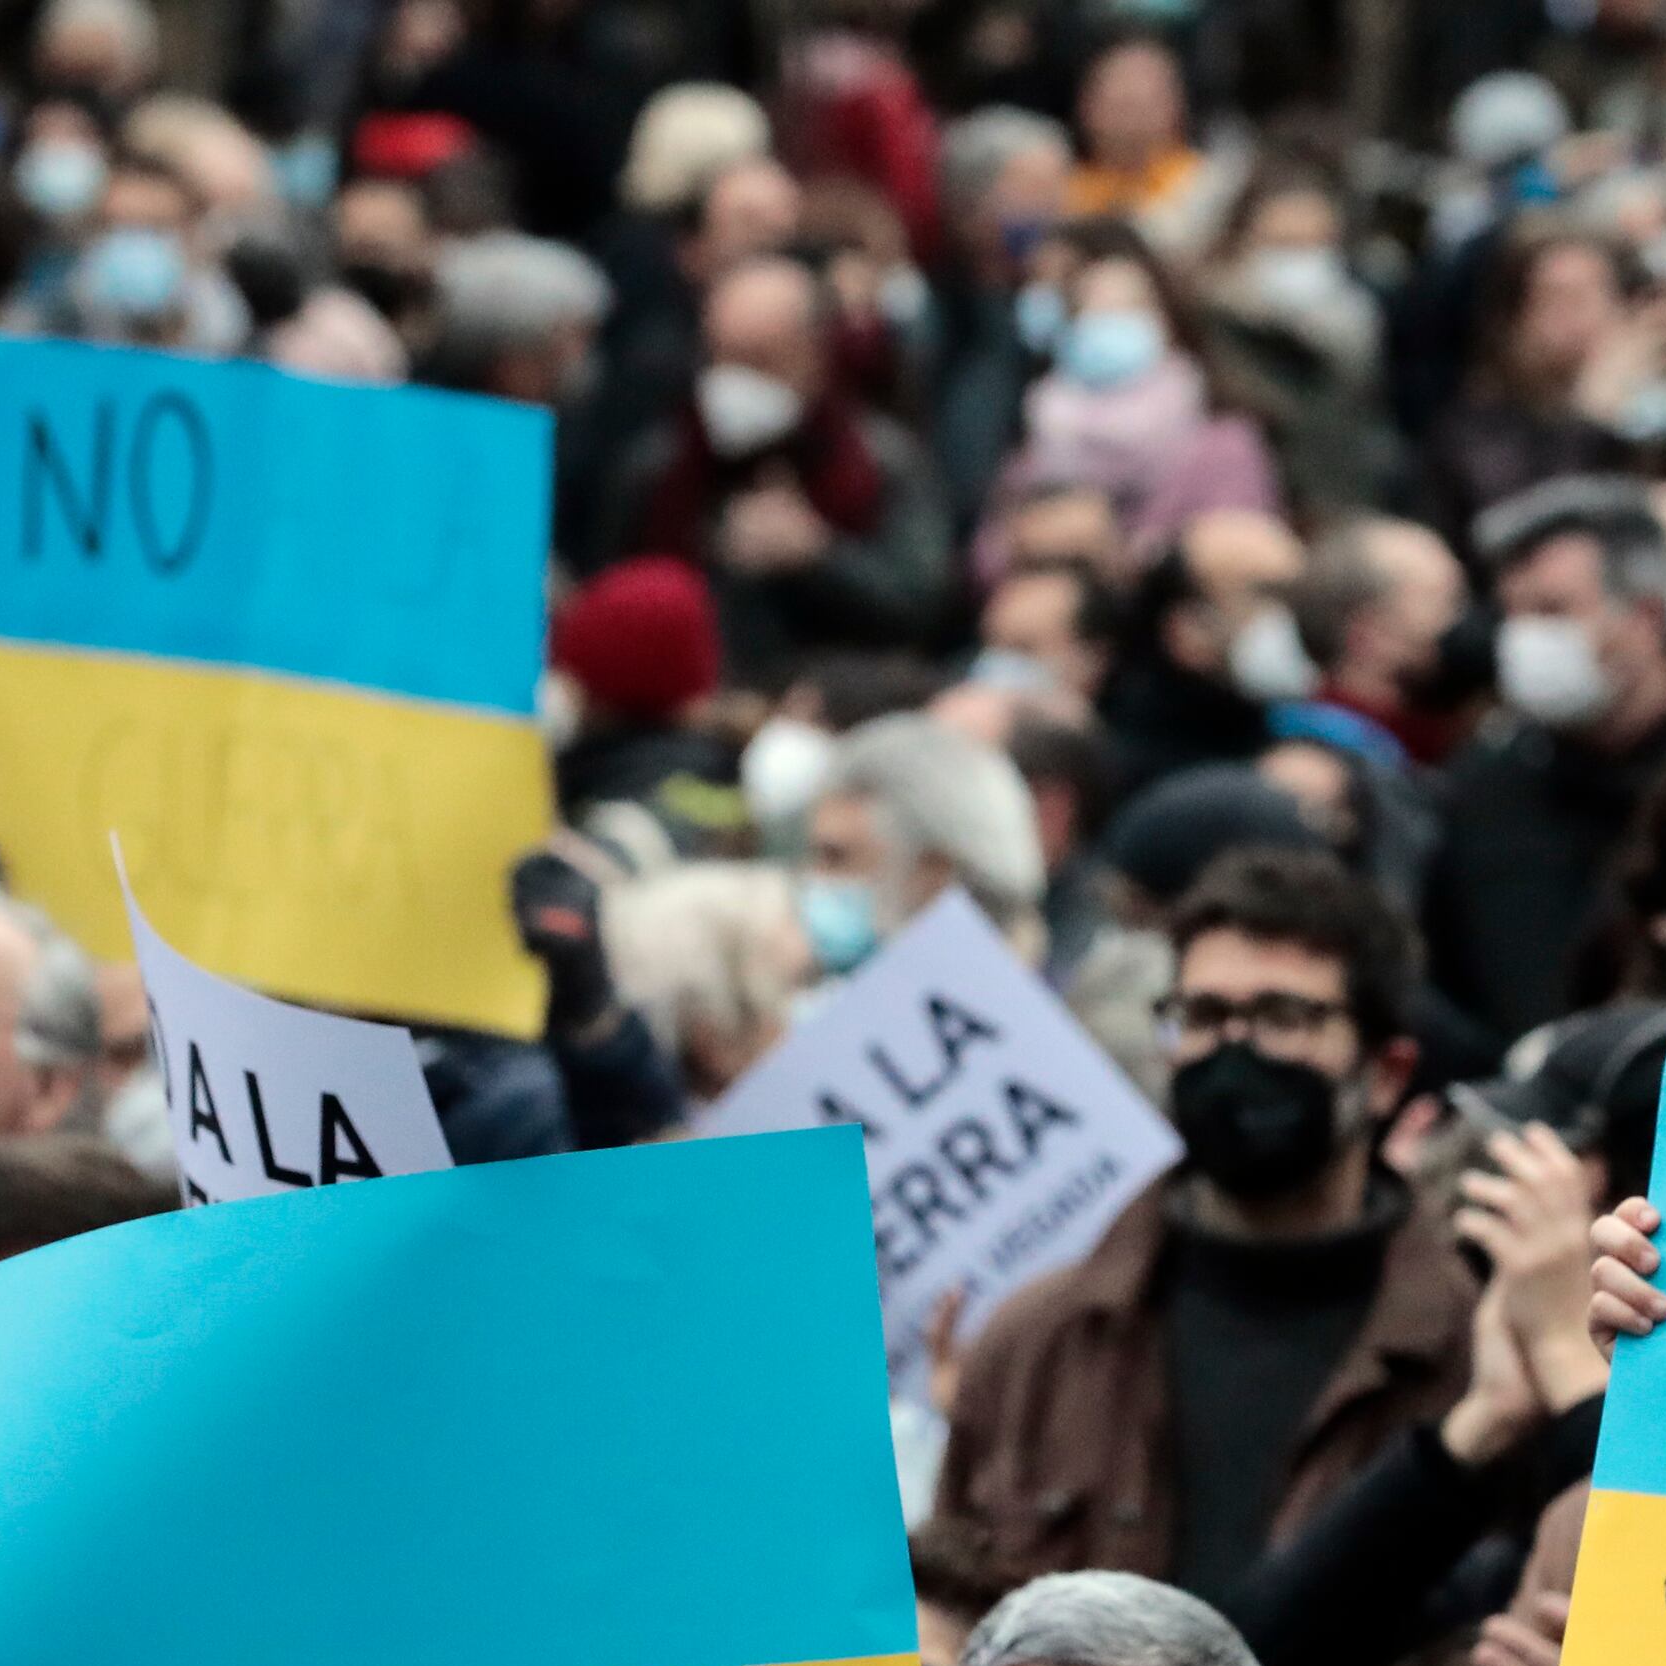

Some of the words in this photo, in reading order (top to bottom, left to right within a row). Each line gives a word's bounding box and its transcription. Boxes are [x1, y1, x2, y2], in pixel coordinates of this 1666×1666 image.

[19, 388, 214, 577] NO
[866, 992, 1003, 1107] LA
[244, 1069, 385, 1187] LA
[871, 1077, 1084, 1278] ERRA
